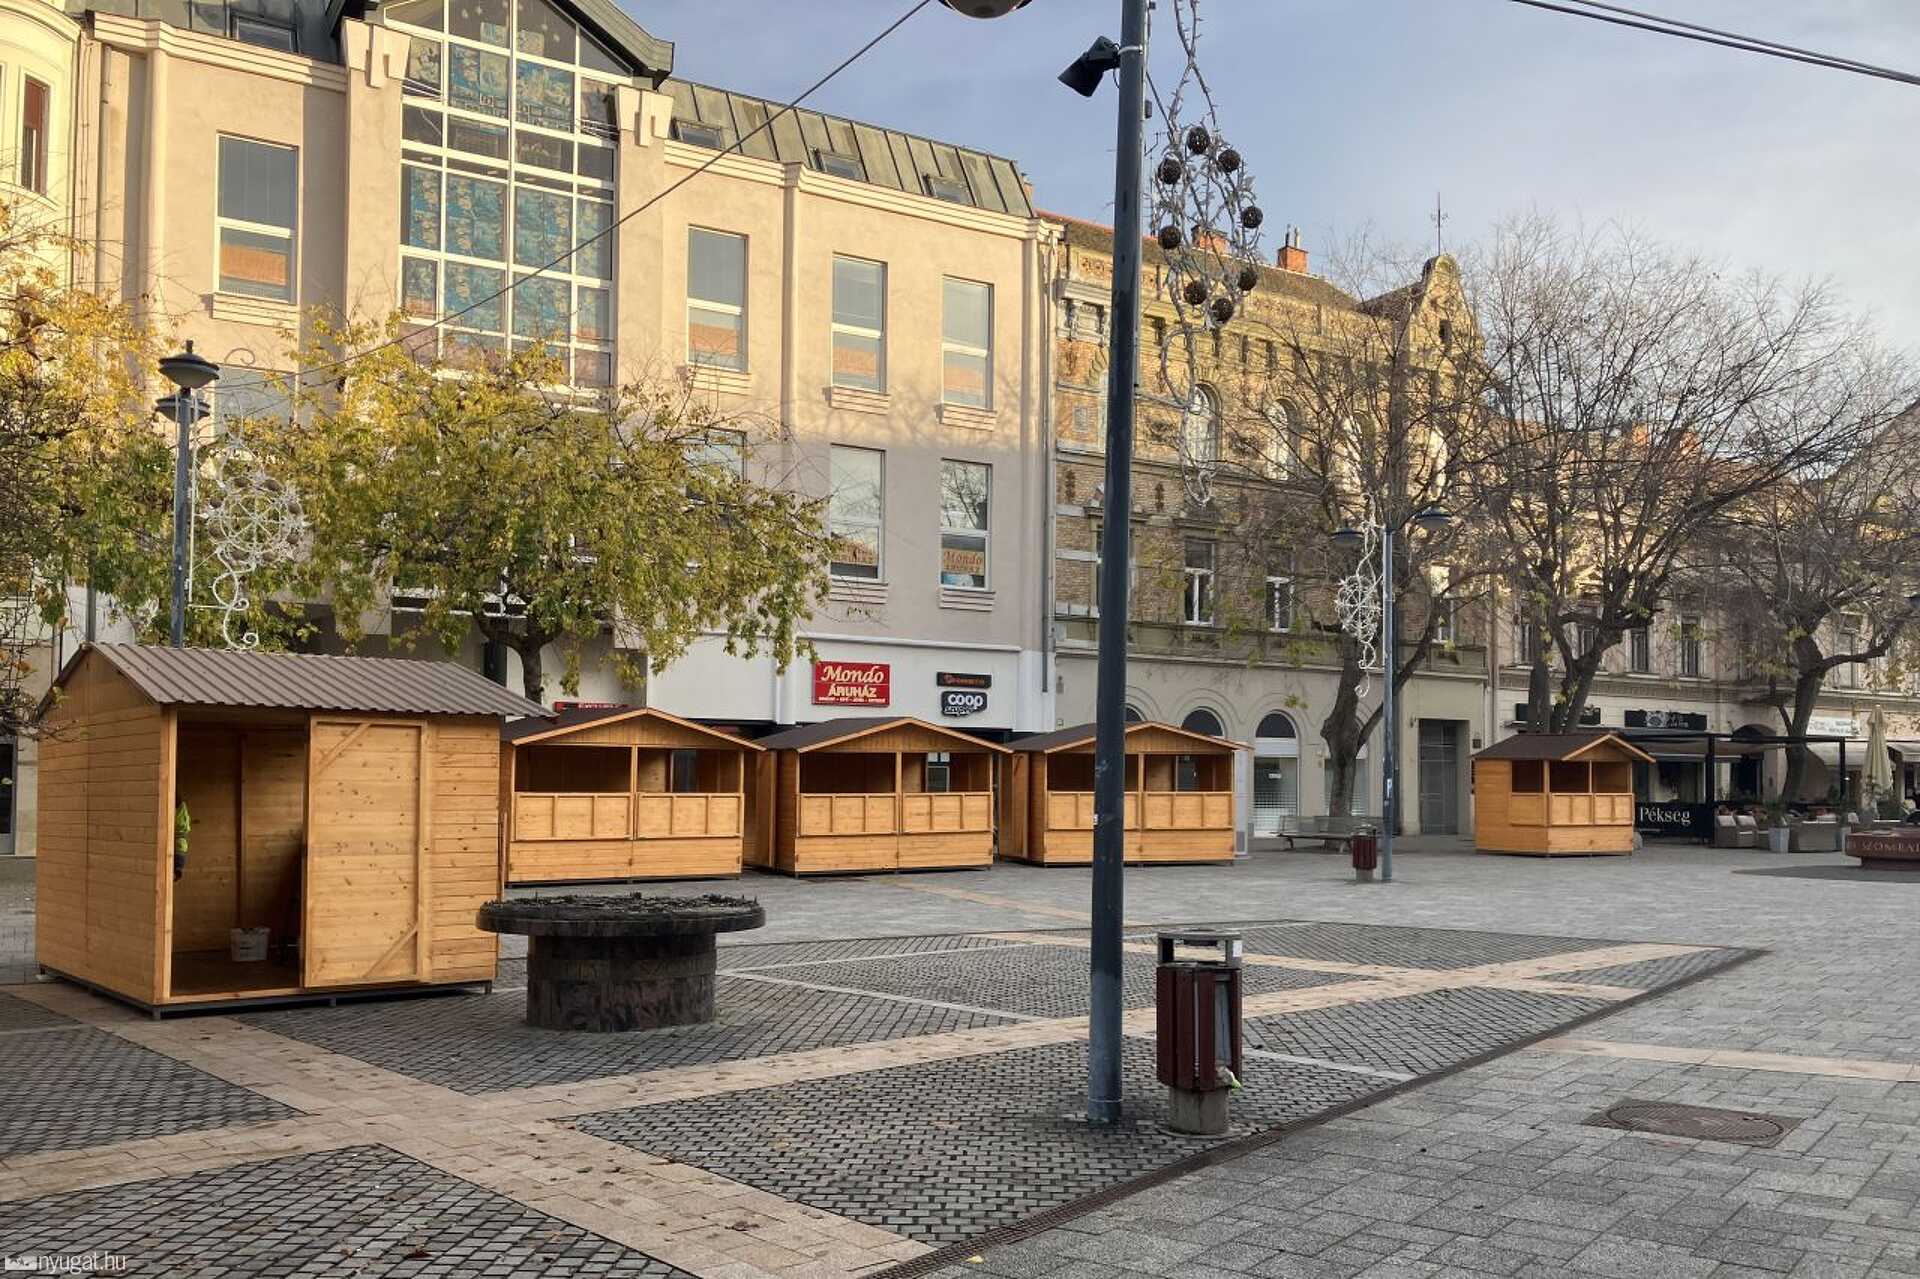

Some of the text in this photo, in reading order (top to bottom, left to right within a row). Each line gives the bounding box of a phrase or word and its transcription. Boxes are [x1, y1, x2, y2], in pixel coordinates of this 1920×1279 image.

[820, 665, 884, 683] Mondo
[828, 683, 877, 697] ÁRUHÁZ
[947, 694, 983, 709] coop
